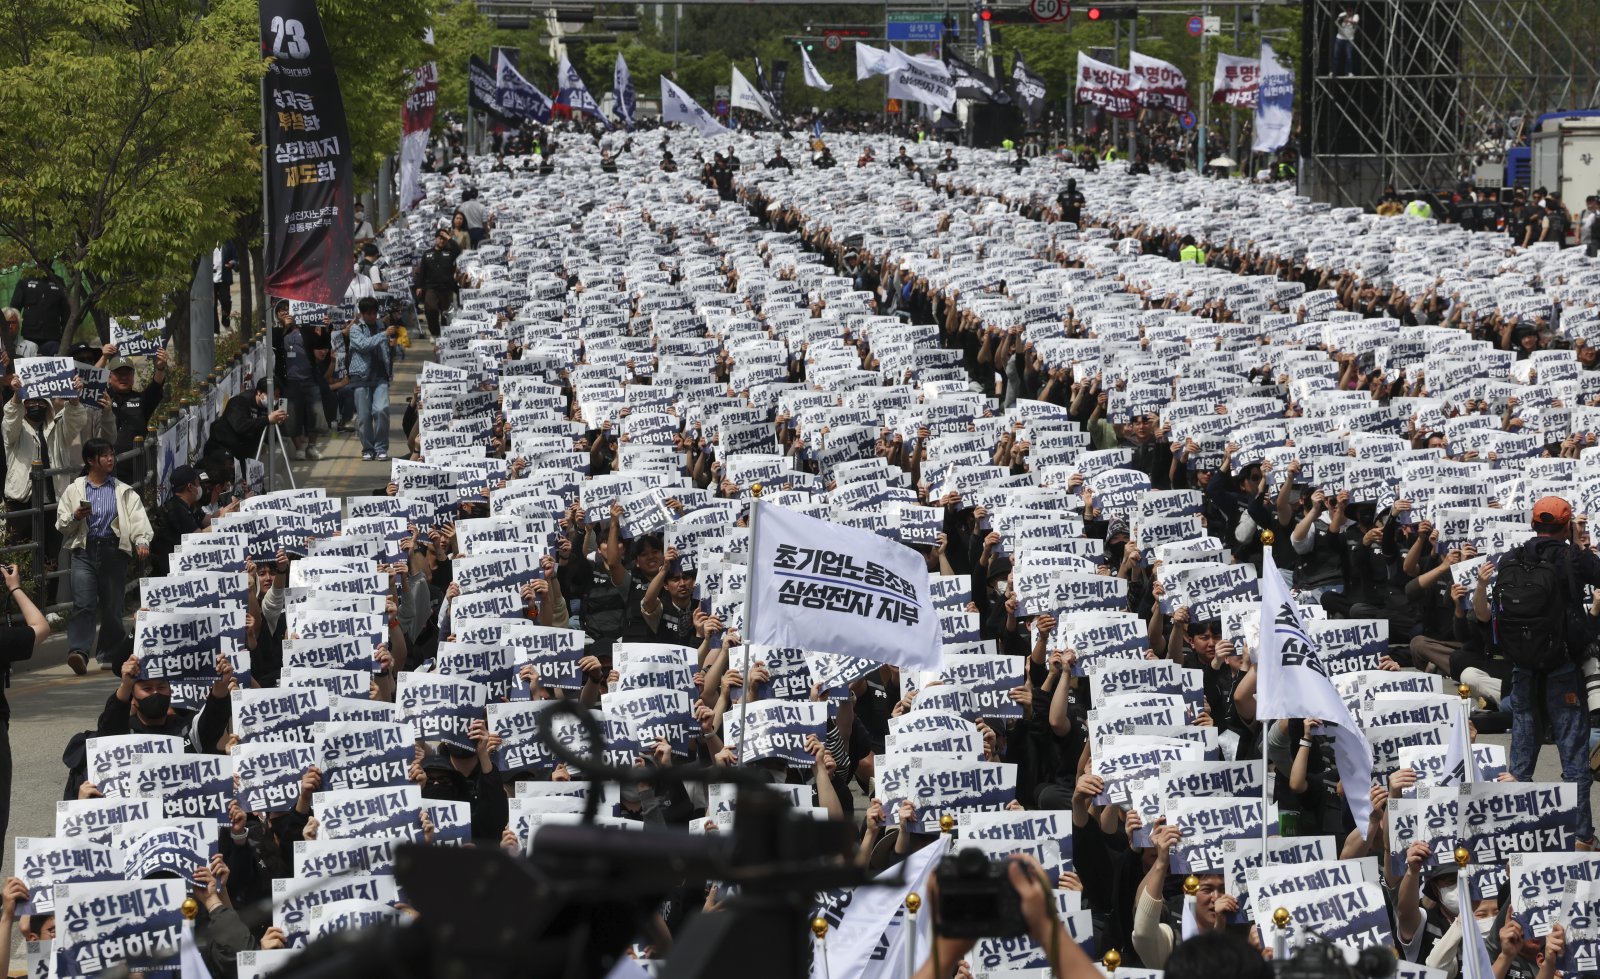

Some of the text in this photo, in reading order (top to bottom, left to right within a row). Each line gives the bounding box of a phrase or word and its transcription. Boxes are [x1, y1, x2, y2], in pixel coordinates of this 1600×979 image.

[1038, 0, 1056, 12] 50
[271, 16, 310, 59] 23
[273, 89, 314, 111] 성과급
[275, 136, 340, 164] 상한폐지
[285, 160, 337, 187] 제도화
[1305, 291, 1334, 305] 상한폐지
[1519, 298, 1550, 311] 상한폐지
[595, 315, 625, 327] 상한폐지
[1023, 305, 1054, 319] 상한폐지
[1262, 315, 1293, 328] 상한폐지
[527, 326, 558, 339] 상한폐지
[672, 317, 704, 331] 상한폐지
[1029, 324, 1060, 339] 상한폐지
[1222, 326, 1255, 338] 상한폐지
[1149, 329, 1181, 340] 상한폐지
[1356, 337, 1389, 350] 상한폐지
[659, 343, 693, 356] 상한폐지
[1390, 342, 1425, 354] 상한폐지
[19, 358, 67, 380] 상한폐지
[425, 368, 462, 381] 상한폐지
[505, 359, 541, 376] 상한폐지
[581, 367, 617, 380] 상한폐지
[748, 370, 783, 380] 상한폐지
[1131, 368, 1168, 382] 상한폐지
[1295, 365, 1333, 379] 상한폐지
[1444, 363, 1482, 382] 상한폐지
[1540, 363, 1577, 378] 상한폐지
[26, 377, 76, 398] 실현하자
[581, 389, 619, 402] 상한폐지
[628, 388, 667, 402] 상한폐지
[687, 385, 723, 402] 상한폐지
[1130, 386, 1167, 400] 상한폐지
[1178, 380, 1217, 396] 상한폐지
[454, 394, 493, 411] 상한폐지
[792, 394, 832, 410] 상한폐지
[872, 394, 911, 410] 상한폐지
[926, 404, 968, 419] 상한폐지
[1020, 405, 1061, 415] 상한폐지
[1235, 401, 1276, 419] 상한폐지
[509, 410, 549, 426] 상한폐지
[720, 409, 761, 425] 상한폐지
[829, 410, 870, 428] 상한폐지
[1168, 404, 1208, 421] 상한폐지
[1350, 410, 1392, 429] 상한폐지
[627, 415, 670, 432] 상한폐지
[1191, 416, 1232, 435] 상한폐지
[1292, 419, 1334, 438] 상한폐지
[424, 435, 466, 450] 상한폐지
[726, 425, 770, 446] 상한폐지
[1040, 433, 1084, 448] 상한폐지
[1233, 430, 1275, 448] 상한폐지
[1494, 435, 1537, 451] 상한폐지
[1298, 441, 1345, 459] 상한폐지
[1360, 440, 1405, 459] 상한폐지
[1078, 453, 1124, 473] 상한폐지
[1528, 461, 1577, 480] 상한폐지
[403, 473, 450, 488] 상한폐지
[734, 464, 781, 484] 상한폐지
[955, 468, 1002, 488] 상한폐지
[1096, 473, 1144, 490] 상한폐지
[1348, 466, 1396, 484] 상한폐지
[583, 481, 633, 502] 상한폐지
[832, 482, 880, 505] 상한폐지
[352, 499, 400, 517] 상한폐지
[1142, 491, 1193, 516] 상한폐지
[464, 527, 519, 550] 상한폐지
[1141, 521, 1195, 543] 상한폐지
[179, 548, 235, 571] 상한폐지
[457, 558, 517, 586] 상한폐지
[773, 543, 918, 601] 초기업노동조합
[1187, 565, 1247, 598] 상한폐지
[146, 577, 209, 607] 상한폐지
[1055, 579, 1119, 600] 상한폐지
[454, 595, 514, 619] 상한폐지
[779, 579, 919, 626] 삼성전자 지부
[140, 617, 212, 647] 상한폐지
[302, 615, 371, 639] 상한폐지
[1072, 621, 1138, 650] 상한폐지
[145, 648, 218, 678] 실현하자
[289, 640, 360, 668] 상한폐지
[439, 649, 506, 674] 상한폐지
[940, 658, 1012, 685] 상한폐지
[1100, 665, 1174, 693] 상한폐지
[401, 683, 475, 708] 상한폐지
[239, 690, 316, 726] 상한폐지
[407, 716, 473, 738] 실현하자
[321, 727, 402, 760] 상한폐지
[238, 747, 314, 780] 상한폐지
[1099, 749, 1181, 775] 상한폐지
[137, 759, 221, 792] 상한폐지
[330, 759, 409, 790] 실현하자
[915, 766, 1002, 798] 상한폐지
[1166, 764, 1254, 798] 상한폐지
[164, 792, 232, 817] 현하자
[322, 789, 408, 829] 상한폐지
[1465, 786, 1562, 826] 상한폐지
[63, 802, 149, 837] 상한폐지
[1176, 802, 1263, 837] 상한폐지
[1474, 825, 1575, 863] 실현하자
[23, 849, 112, 879] 상한폐지
[301, 841, 393, 878] 상한폐지
[64, 883, 170, 933] 상한폐지
[76, 926, 181, 974] 실현하자
